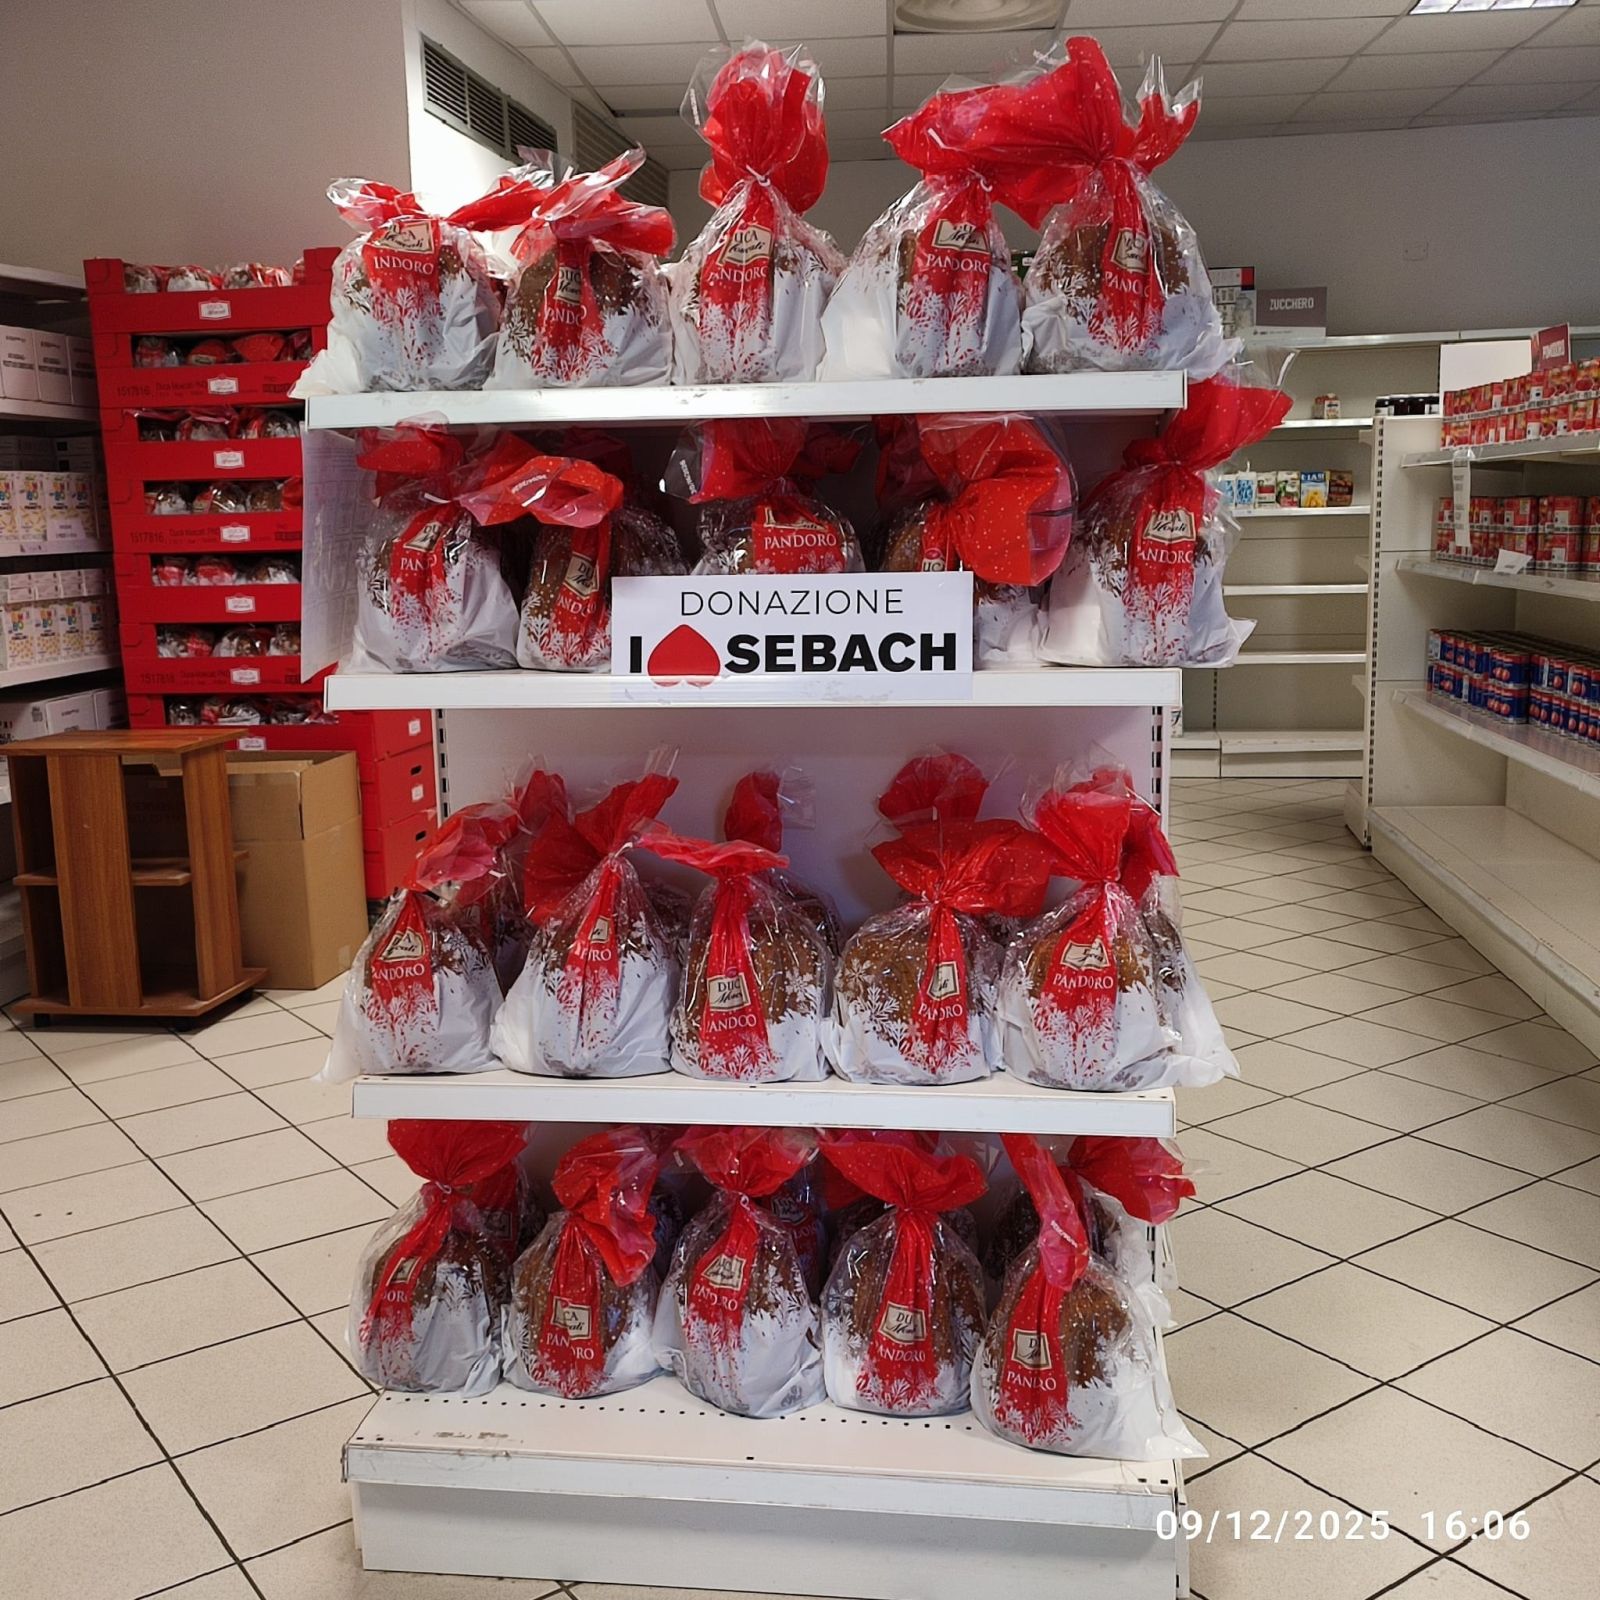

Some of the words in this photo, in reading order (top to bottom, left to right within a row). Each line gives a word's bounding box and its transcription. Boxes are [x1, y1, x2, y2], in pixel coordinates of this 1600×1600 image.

[1269, 297, 1314, 311] ZUCCHERO
[763, 534, 838, 550] PANDORO
[681, 589, 904, 616] DONAZIONE
[630, 636, 642, 673] I
[724, 632, 957, 673] SEBACH
